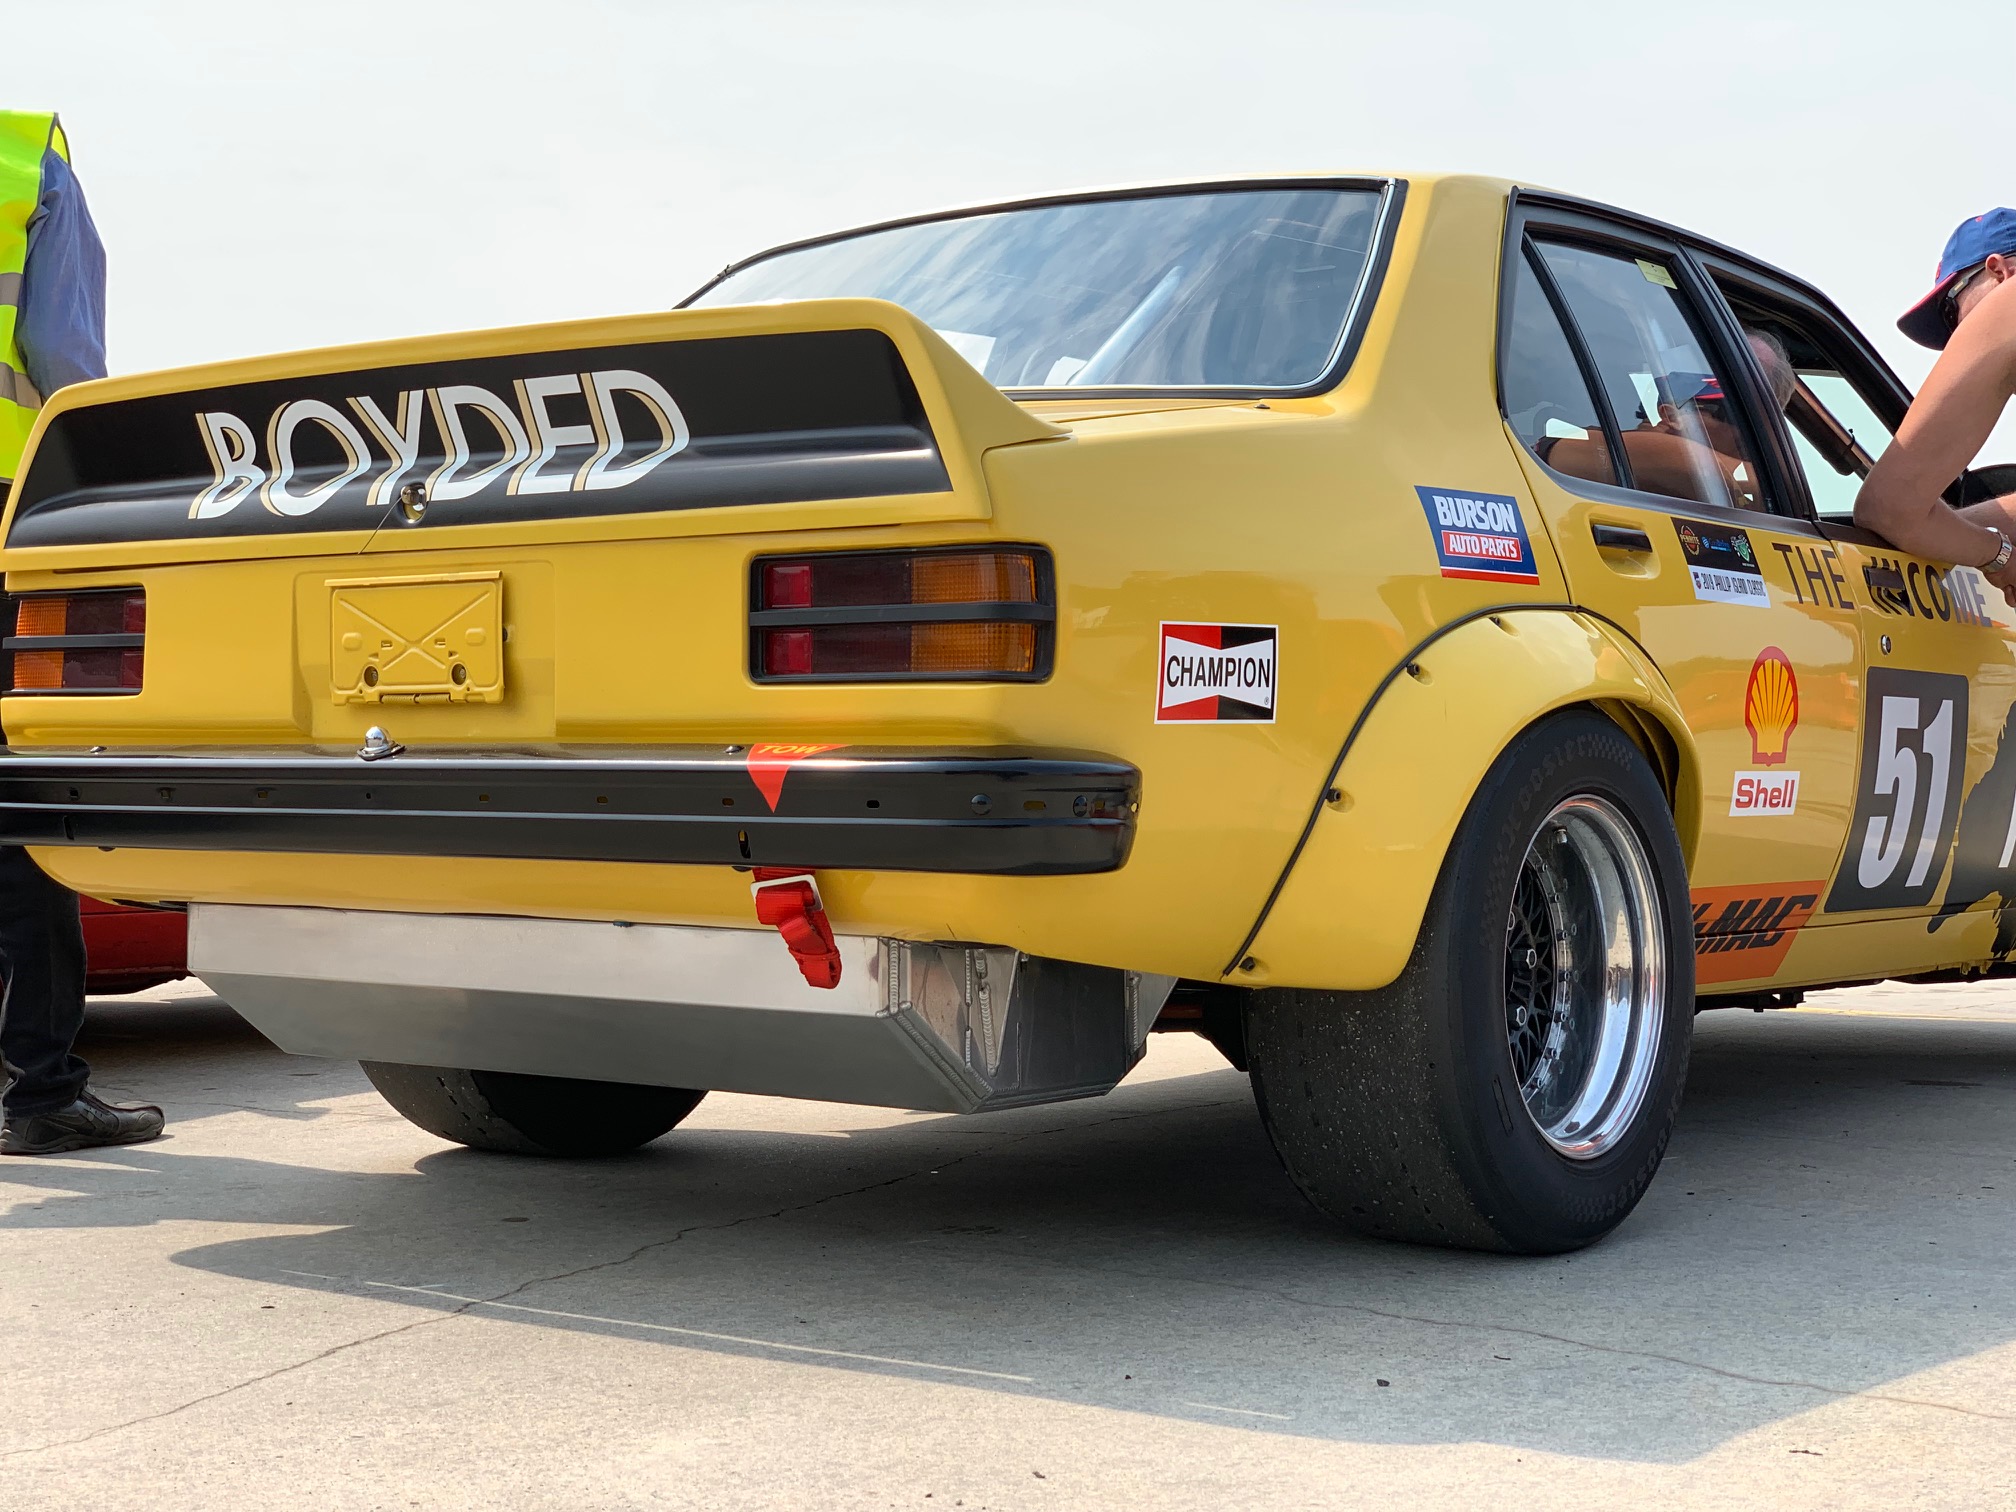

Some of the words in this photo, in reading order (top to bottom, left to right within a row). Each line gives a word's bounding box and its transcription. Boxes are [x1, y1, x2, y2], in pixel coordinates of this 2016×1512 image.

[188, 369, 691, 520] BOYDED
[1432, 495, 1517, 533] BURSON
[1449, 533, 1480, 555] AUTO
[1480, 536, 1518, 558] PARTS
[1772, 542, 1855, 610] THE
[1166, 655, 1271, 688] CHAMPION
[758, 744, 825, 755] TOW
[1735, 778, 1795, 810] Shell
[1857, 695, 1954, 890] 51
